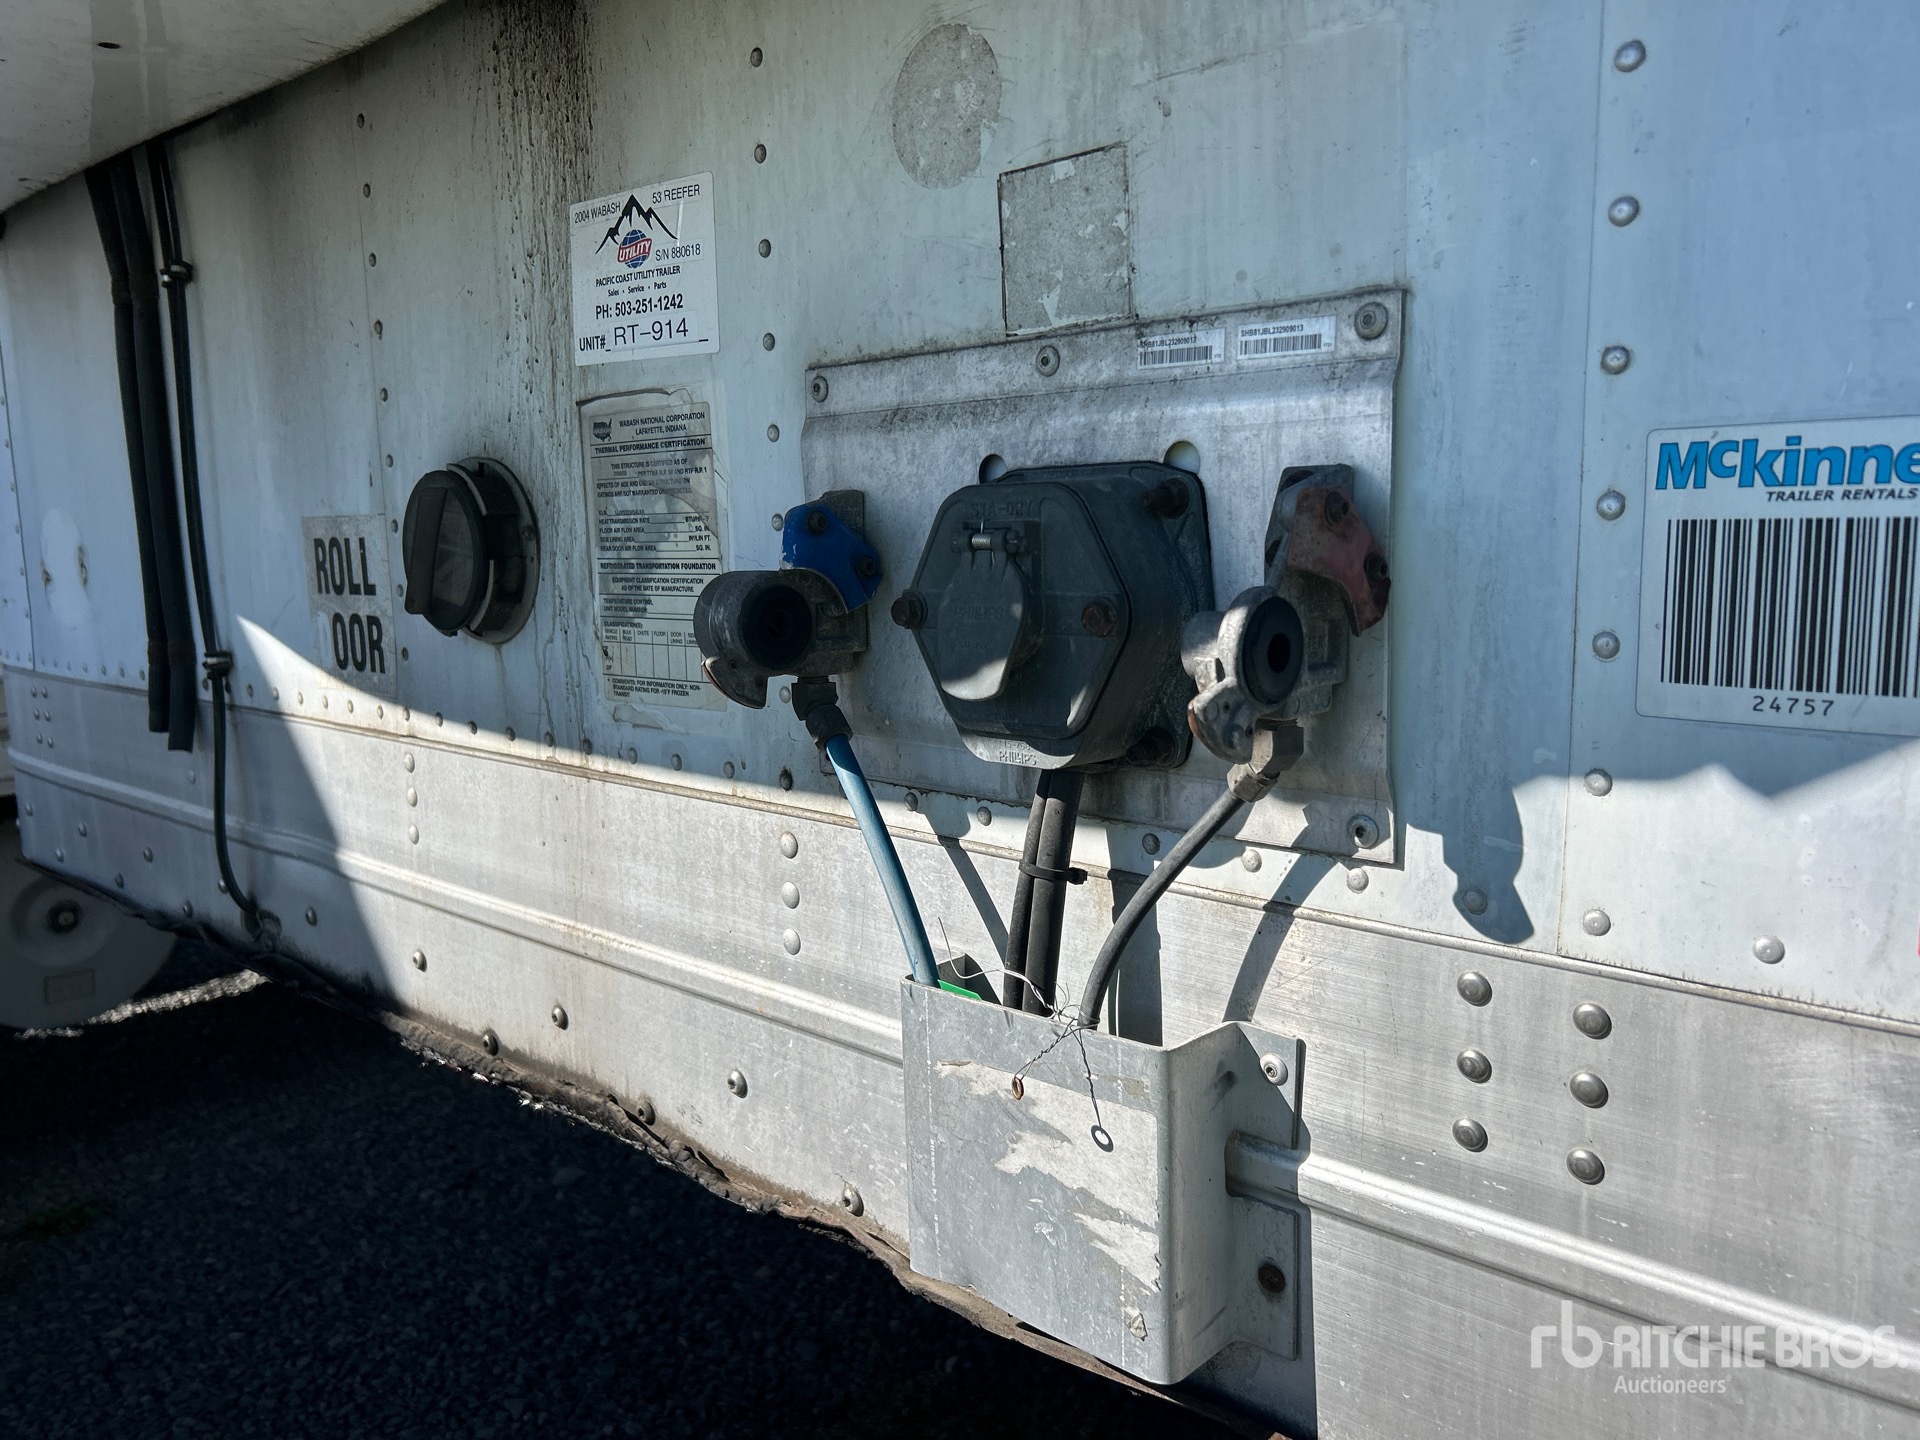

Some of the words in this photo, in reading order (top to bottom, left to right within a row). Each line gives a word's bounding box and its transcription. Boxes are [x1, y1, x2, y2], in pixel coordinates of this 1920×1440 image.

[664, 184, 700, 201] REEFER
[575, 212, 590, 223] 2004
[591, 202, 621, 219] WABASH
[619, 240, 651, 262] UTILITY
[655, 249, 669, 261] S/N
[671, 243, 701, 258] 880618
[595, 275, 615, 287] PACIFIC
[616, 272, 633, 284] COAST
[633, 269, 655, 281] UTILITY
[655, 265, 681, 278] TRAILER
[608, 289, 619, 297] Sales
[628, 285, 644, 294] Service
[654, 281, 667, 290] Parts
[595, 305, 612, 319] PH:
[615, 294, 683, 317] 503-251-1242
[614, 318, 689, 346] RT-914
[619, 419, 640, 428] WABASH
[640, 416, 665, 425] NATIONAL
[666, 412, 705, 423] CORPORATION
[635, 426, 664, 436] LAFAYETTE,
[665, 424, 687, 433] INDIANA
[595, 446, 618, 455] THERMAL
[620, 442, 660, 453] PERFORMANCE
[660, 438, 706, 449] CERTIFICATION
[621, 461, 644, 469] STRUCTURE
[1766, 490, 1834, 502] TRAILER
[1841, 488, 1919, 500] RENTALS
[314, 537, 376, 596] ROLL
[333, 612, 386, 674] OOR
[646, 681, 675, 689] INFORMATION
[1752, 696, 1834, 716] 24757
[999, 750, 1038, 766] PHILLIPS
